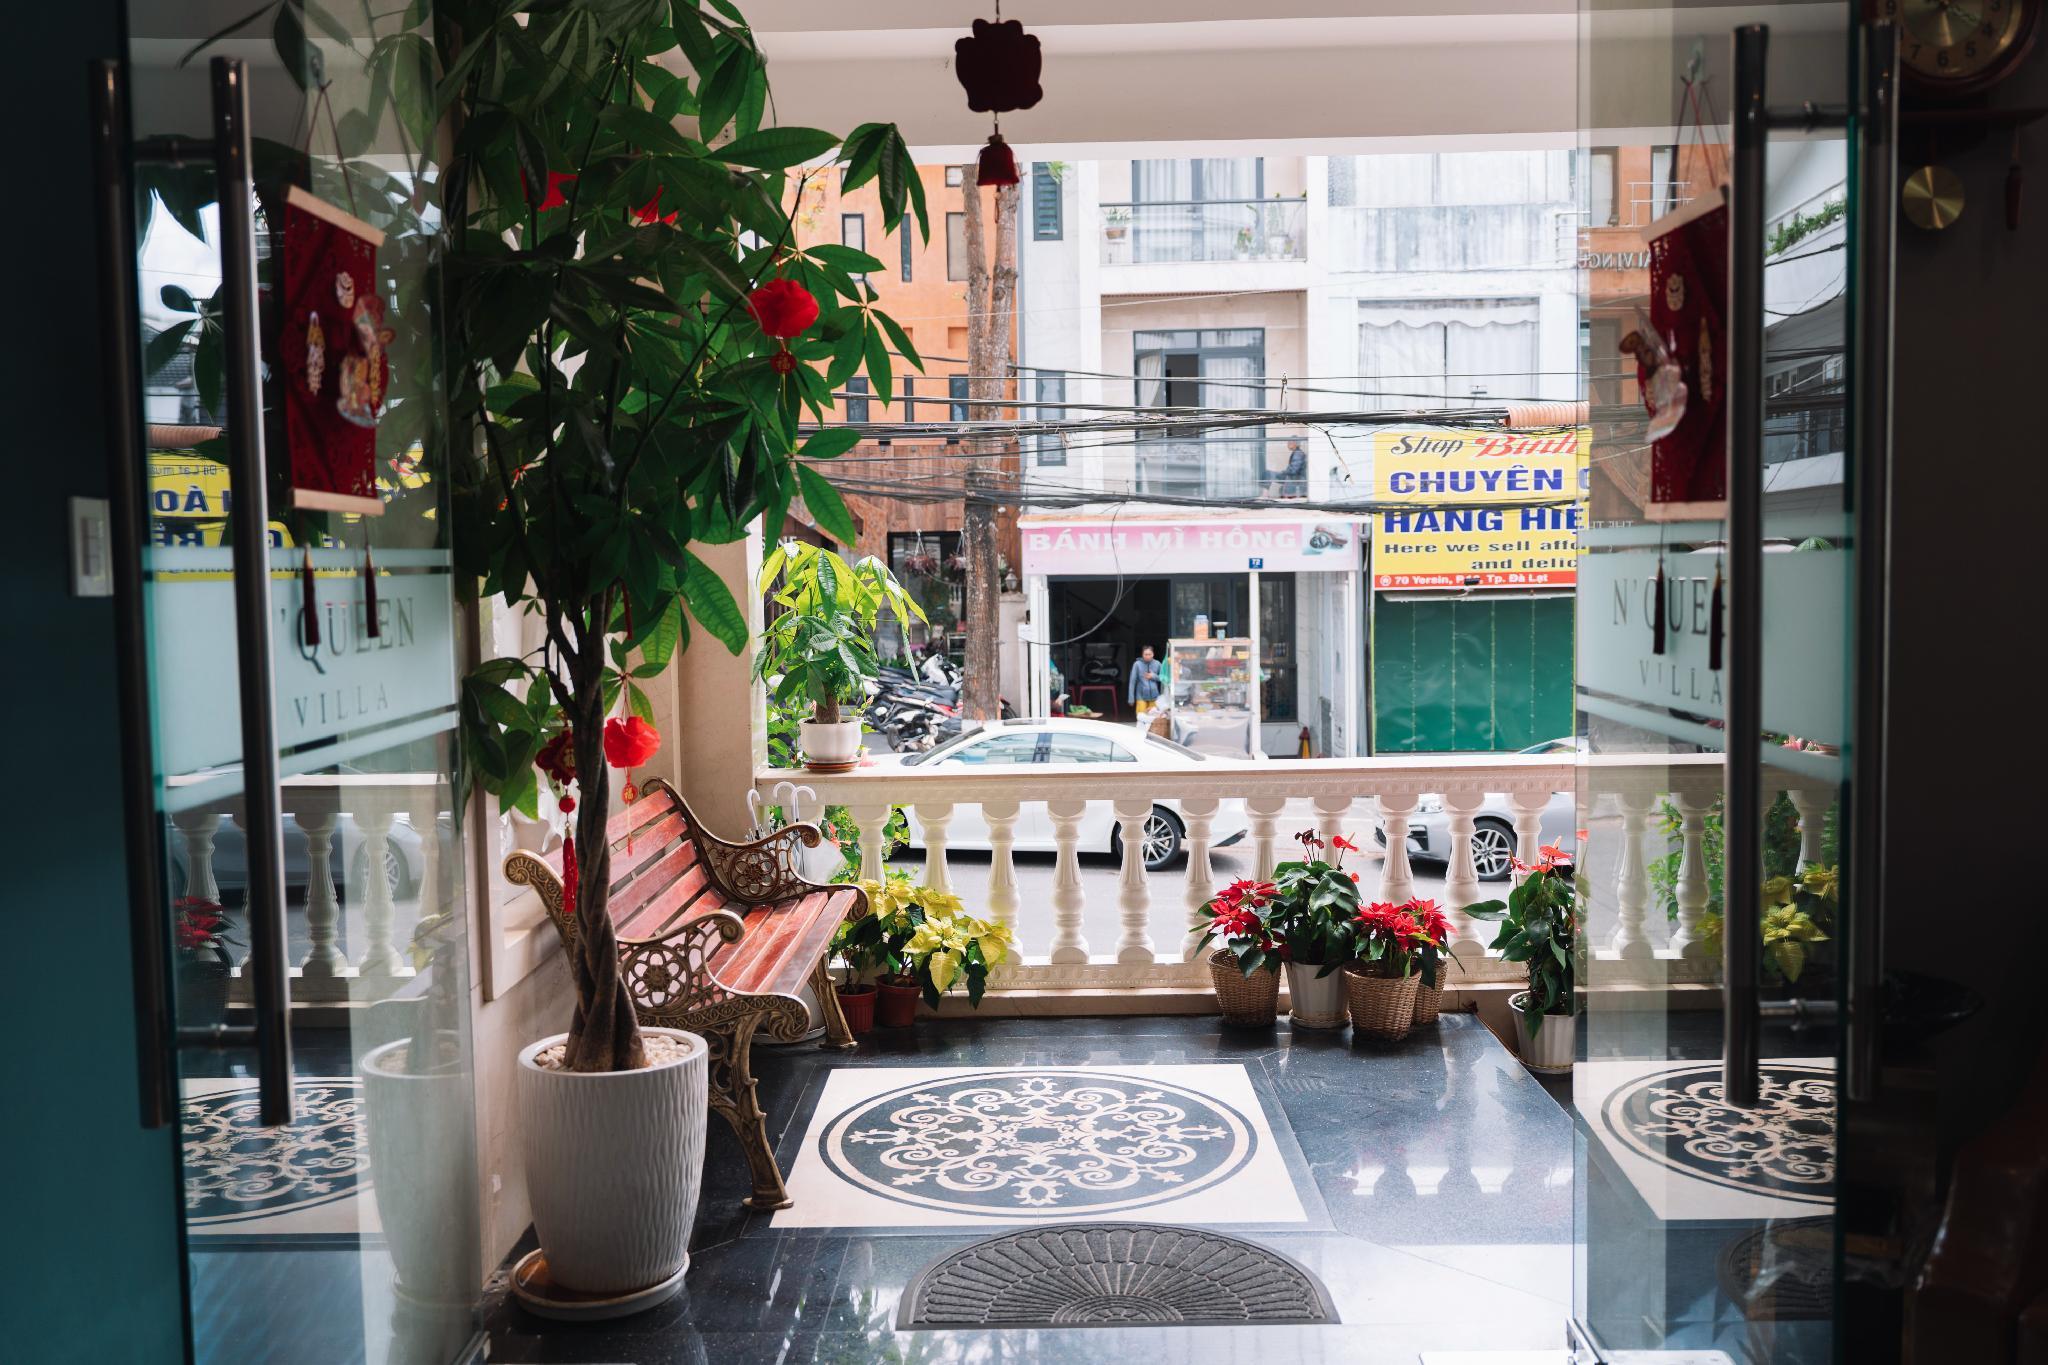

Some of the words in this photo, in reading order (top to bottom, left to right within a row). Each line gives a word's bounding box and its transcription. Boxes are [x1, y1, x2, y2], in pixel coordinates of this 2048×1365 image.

[1390, 435, 1464, 457] Shop
[1390, 465, 1563, 494] CHUYÊN
[1029, 529, 1128, 551] BÁNH
[1141, 528, 1185, 550] MÌ
[1384, 544, 1437, 554] Here
[1446, 543, 1480, 553] we
[1488, 540, 1530, 551] sell
[1471, 558, 1512, 570] and
[1639, 659, 1724, 706] VILLA
[293, 683, 389, 728] VILLA
